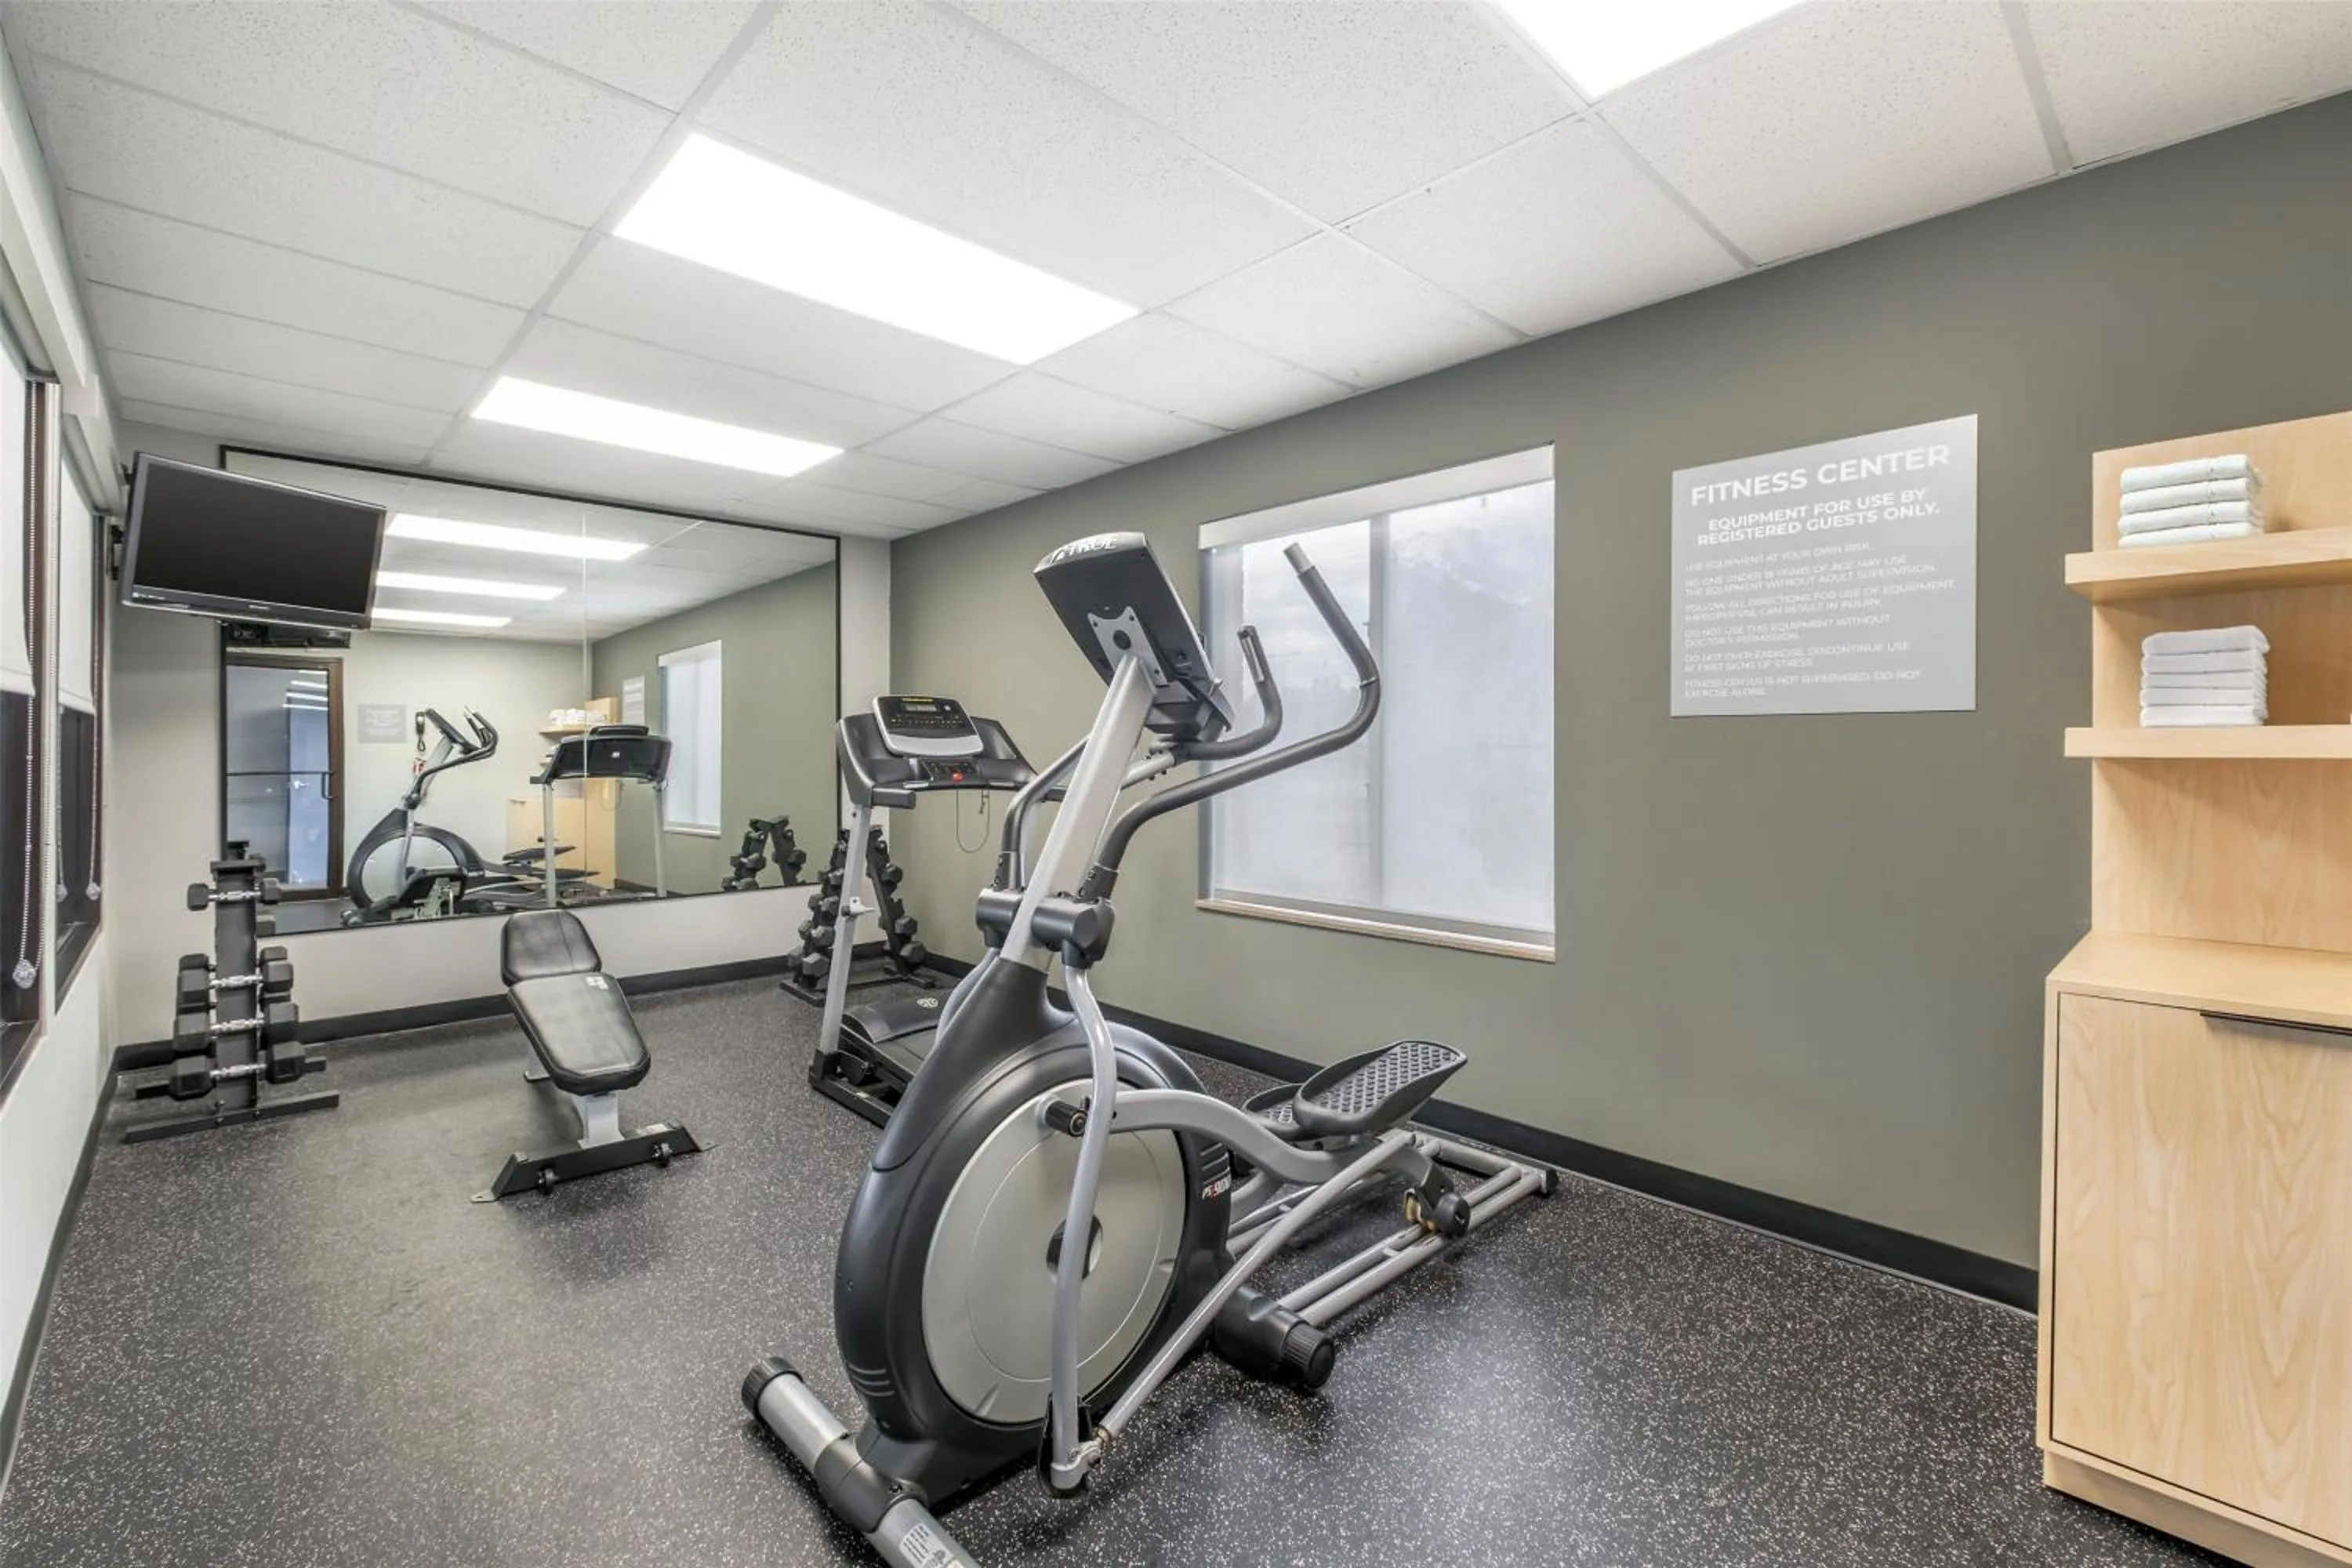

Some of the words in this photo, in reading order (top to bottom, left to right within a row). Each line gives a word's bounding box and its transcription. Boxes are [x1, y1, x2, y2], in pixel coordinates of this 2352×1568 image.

[1691, 468, 1808, 506] FITNESS
[1817, 445, 1951, 485] CENTER
[1697, 521, 1802, 546] REGISTERED
[1806, 510, 1879, 532] GUESTS
[1883, 501, 1941, 521] ONLY.
[1708, 505, 1809, 532] EQUIPMENT
[1813, 499, 1852, 516] FOR
[1857, 492, 1895, 510] USE
[1900, 488, 1927, 503] BY
